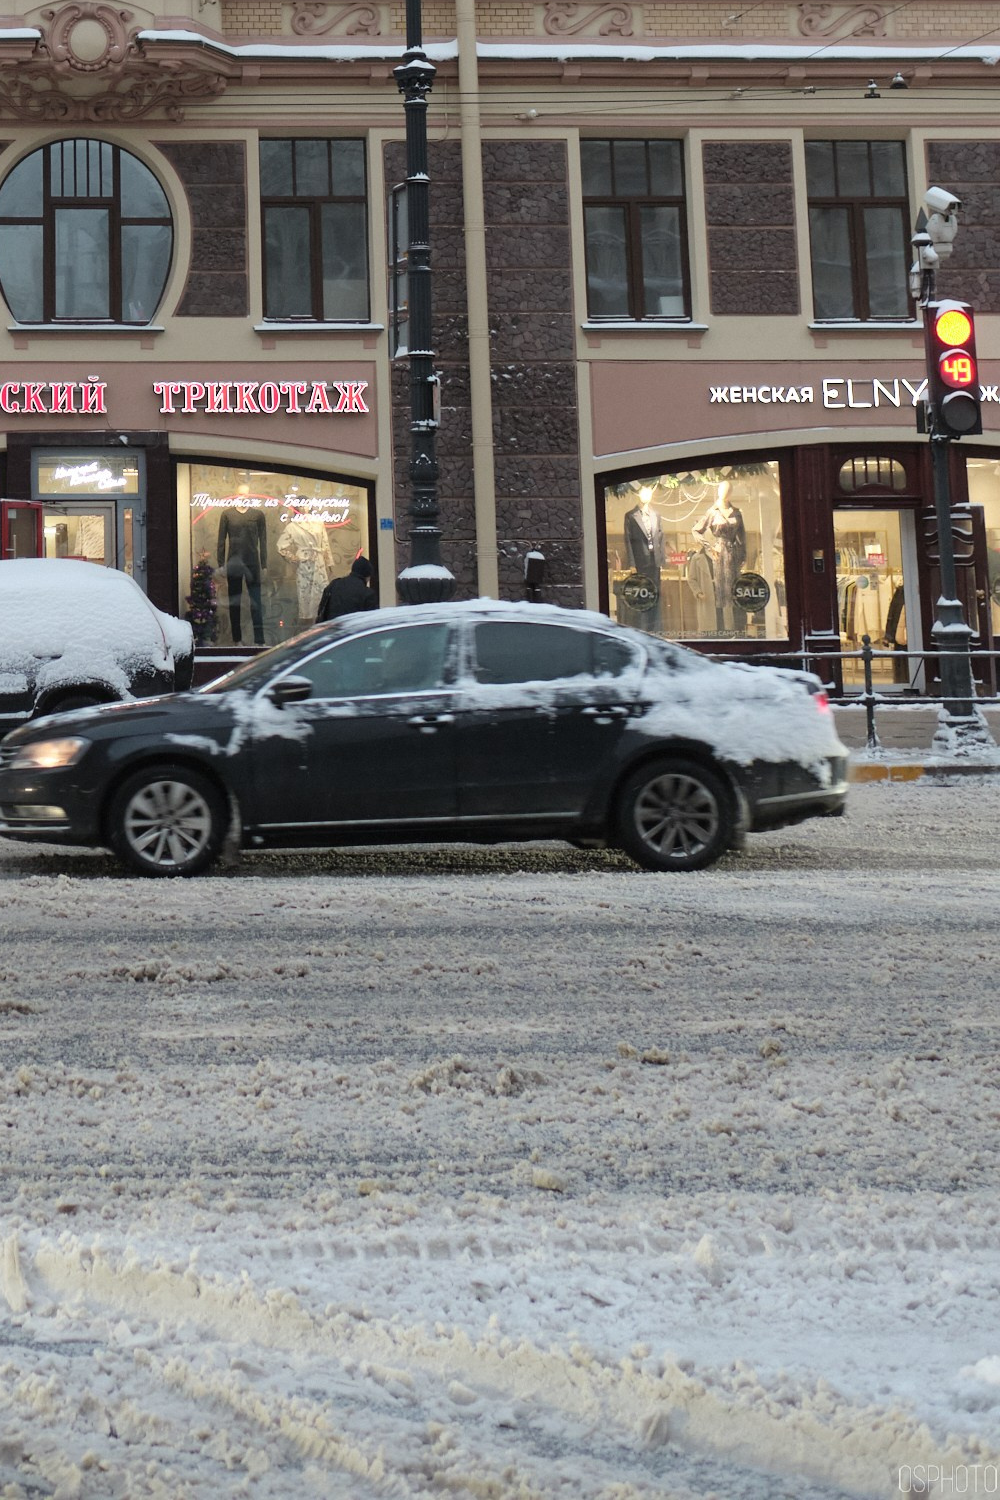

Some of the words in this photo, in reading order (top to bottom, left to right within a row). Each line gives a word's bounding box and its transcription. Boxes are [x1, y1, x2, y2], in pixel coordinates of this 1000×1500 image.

[944, 358, 972, 383] 49
[153, 381, 369, 414] ТРИКОТАЖ
[709, 386, 814, 404] ЖЕНСКАЯ
[822, 378, 929, 408] ELNY
[190, 493, 263, 510] Трикотаж
[264, 498, 278, 508] из
[736, 587, 766, 598] SALE
